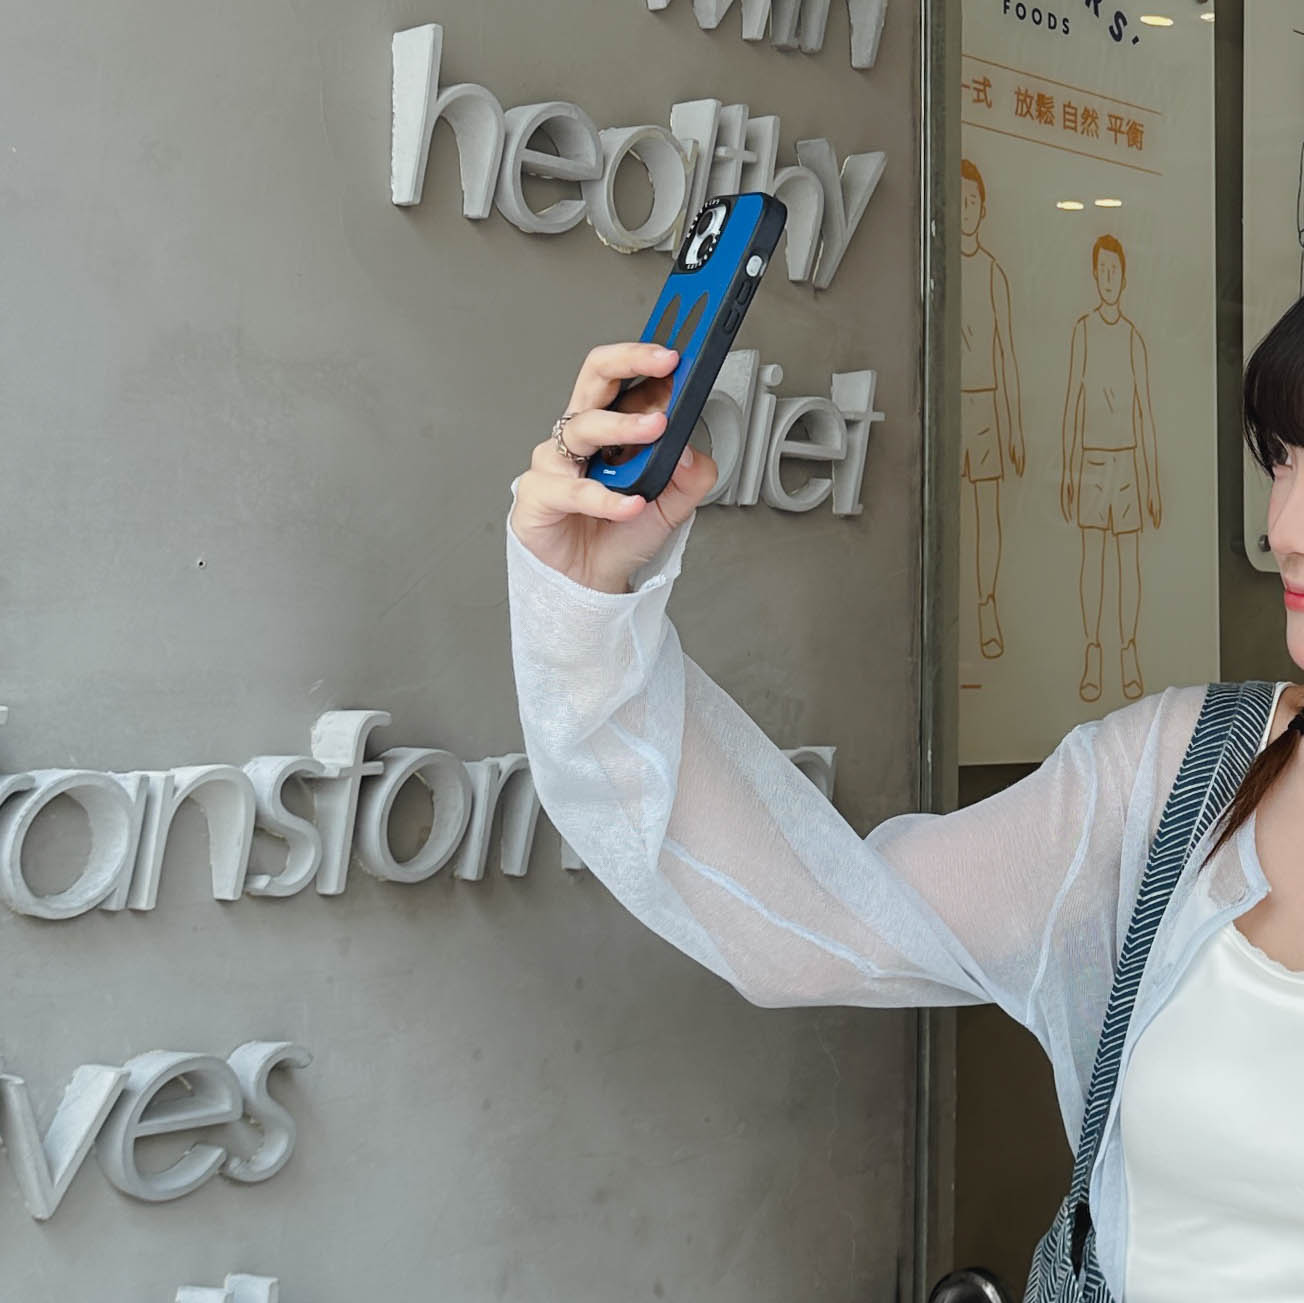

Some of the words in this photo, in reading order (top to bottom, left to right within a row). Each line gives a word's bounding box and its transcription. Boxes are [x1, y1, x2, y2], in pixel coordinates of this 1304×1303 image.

[391, 23, 887, 289] healthy
[1014, 86, 1056, 127] 放鬆
[1062, 100, 1100, 139] 自然
[1106, 113, 1145, 151] 平衡
